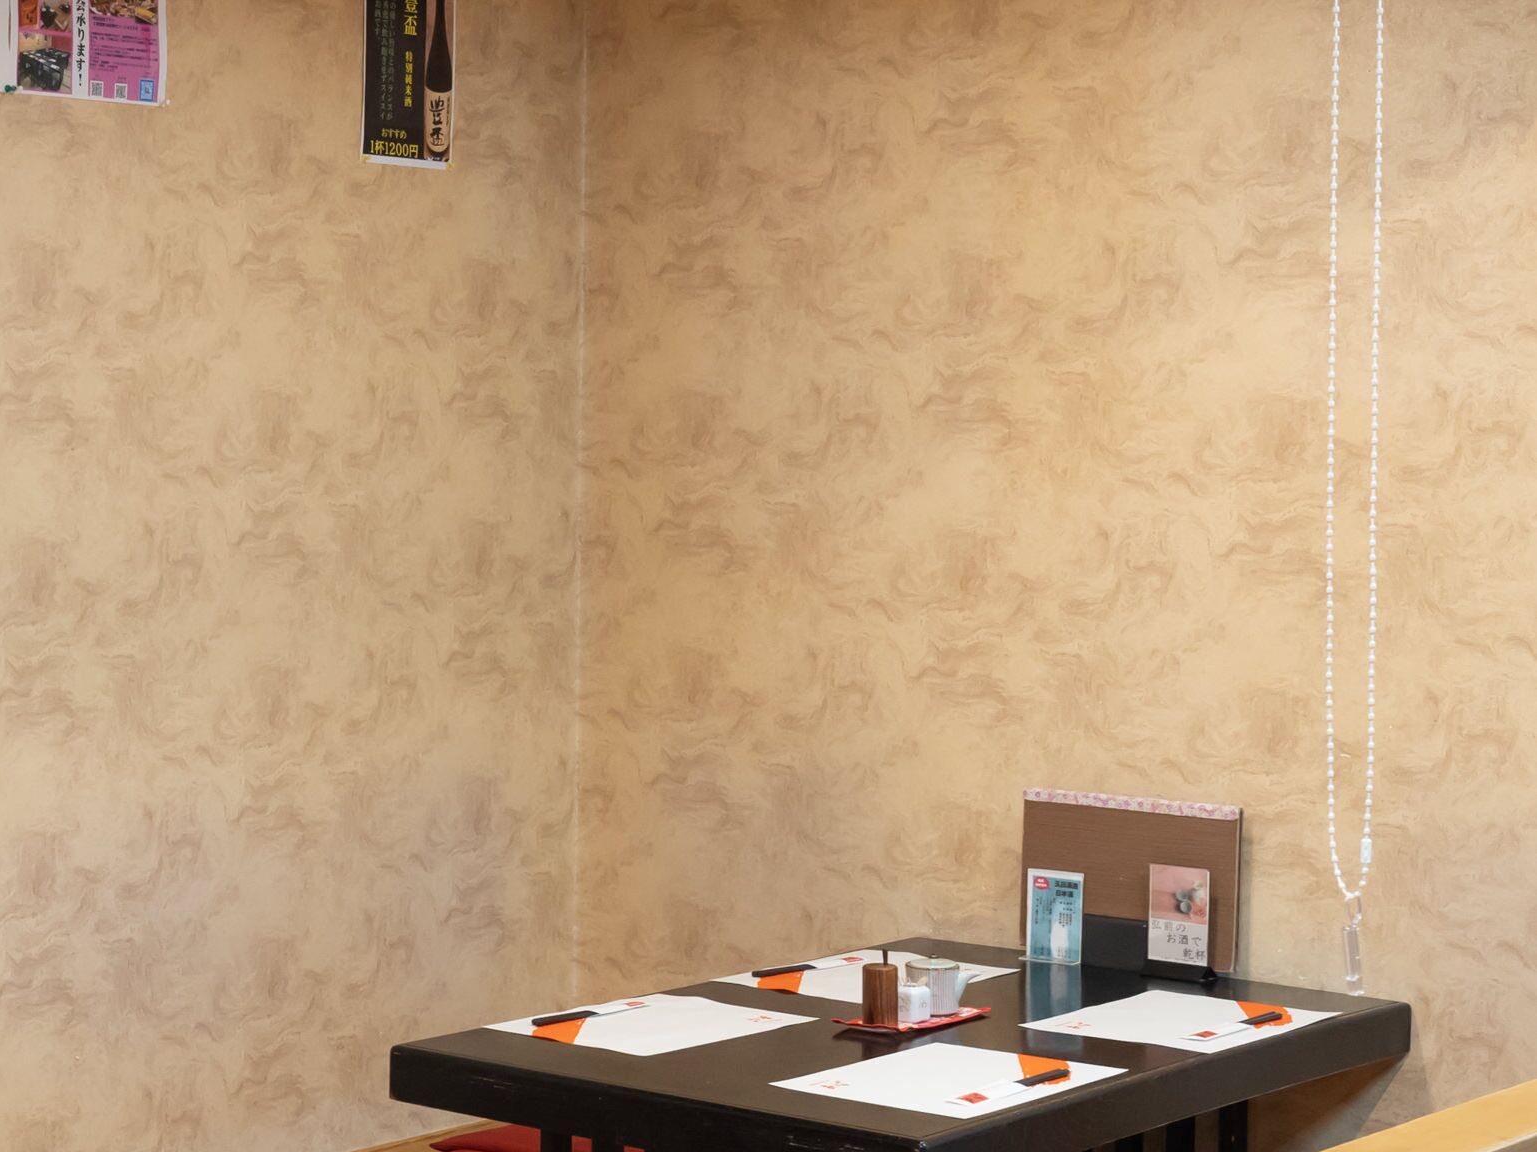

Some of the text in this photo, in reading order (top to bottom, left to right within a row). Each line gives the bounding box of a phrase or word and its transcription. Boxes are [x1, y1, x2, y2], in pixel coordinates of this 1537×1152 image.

[404, 50, 413, 108] 特別純米酒
[381, 127, 407, 139] おすすめ
[370, 139, 419, 158] 1杯1200円
[1166, 931, 1202, 947] お酒で
[1182, 947, 1206, 961] 乾杯
